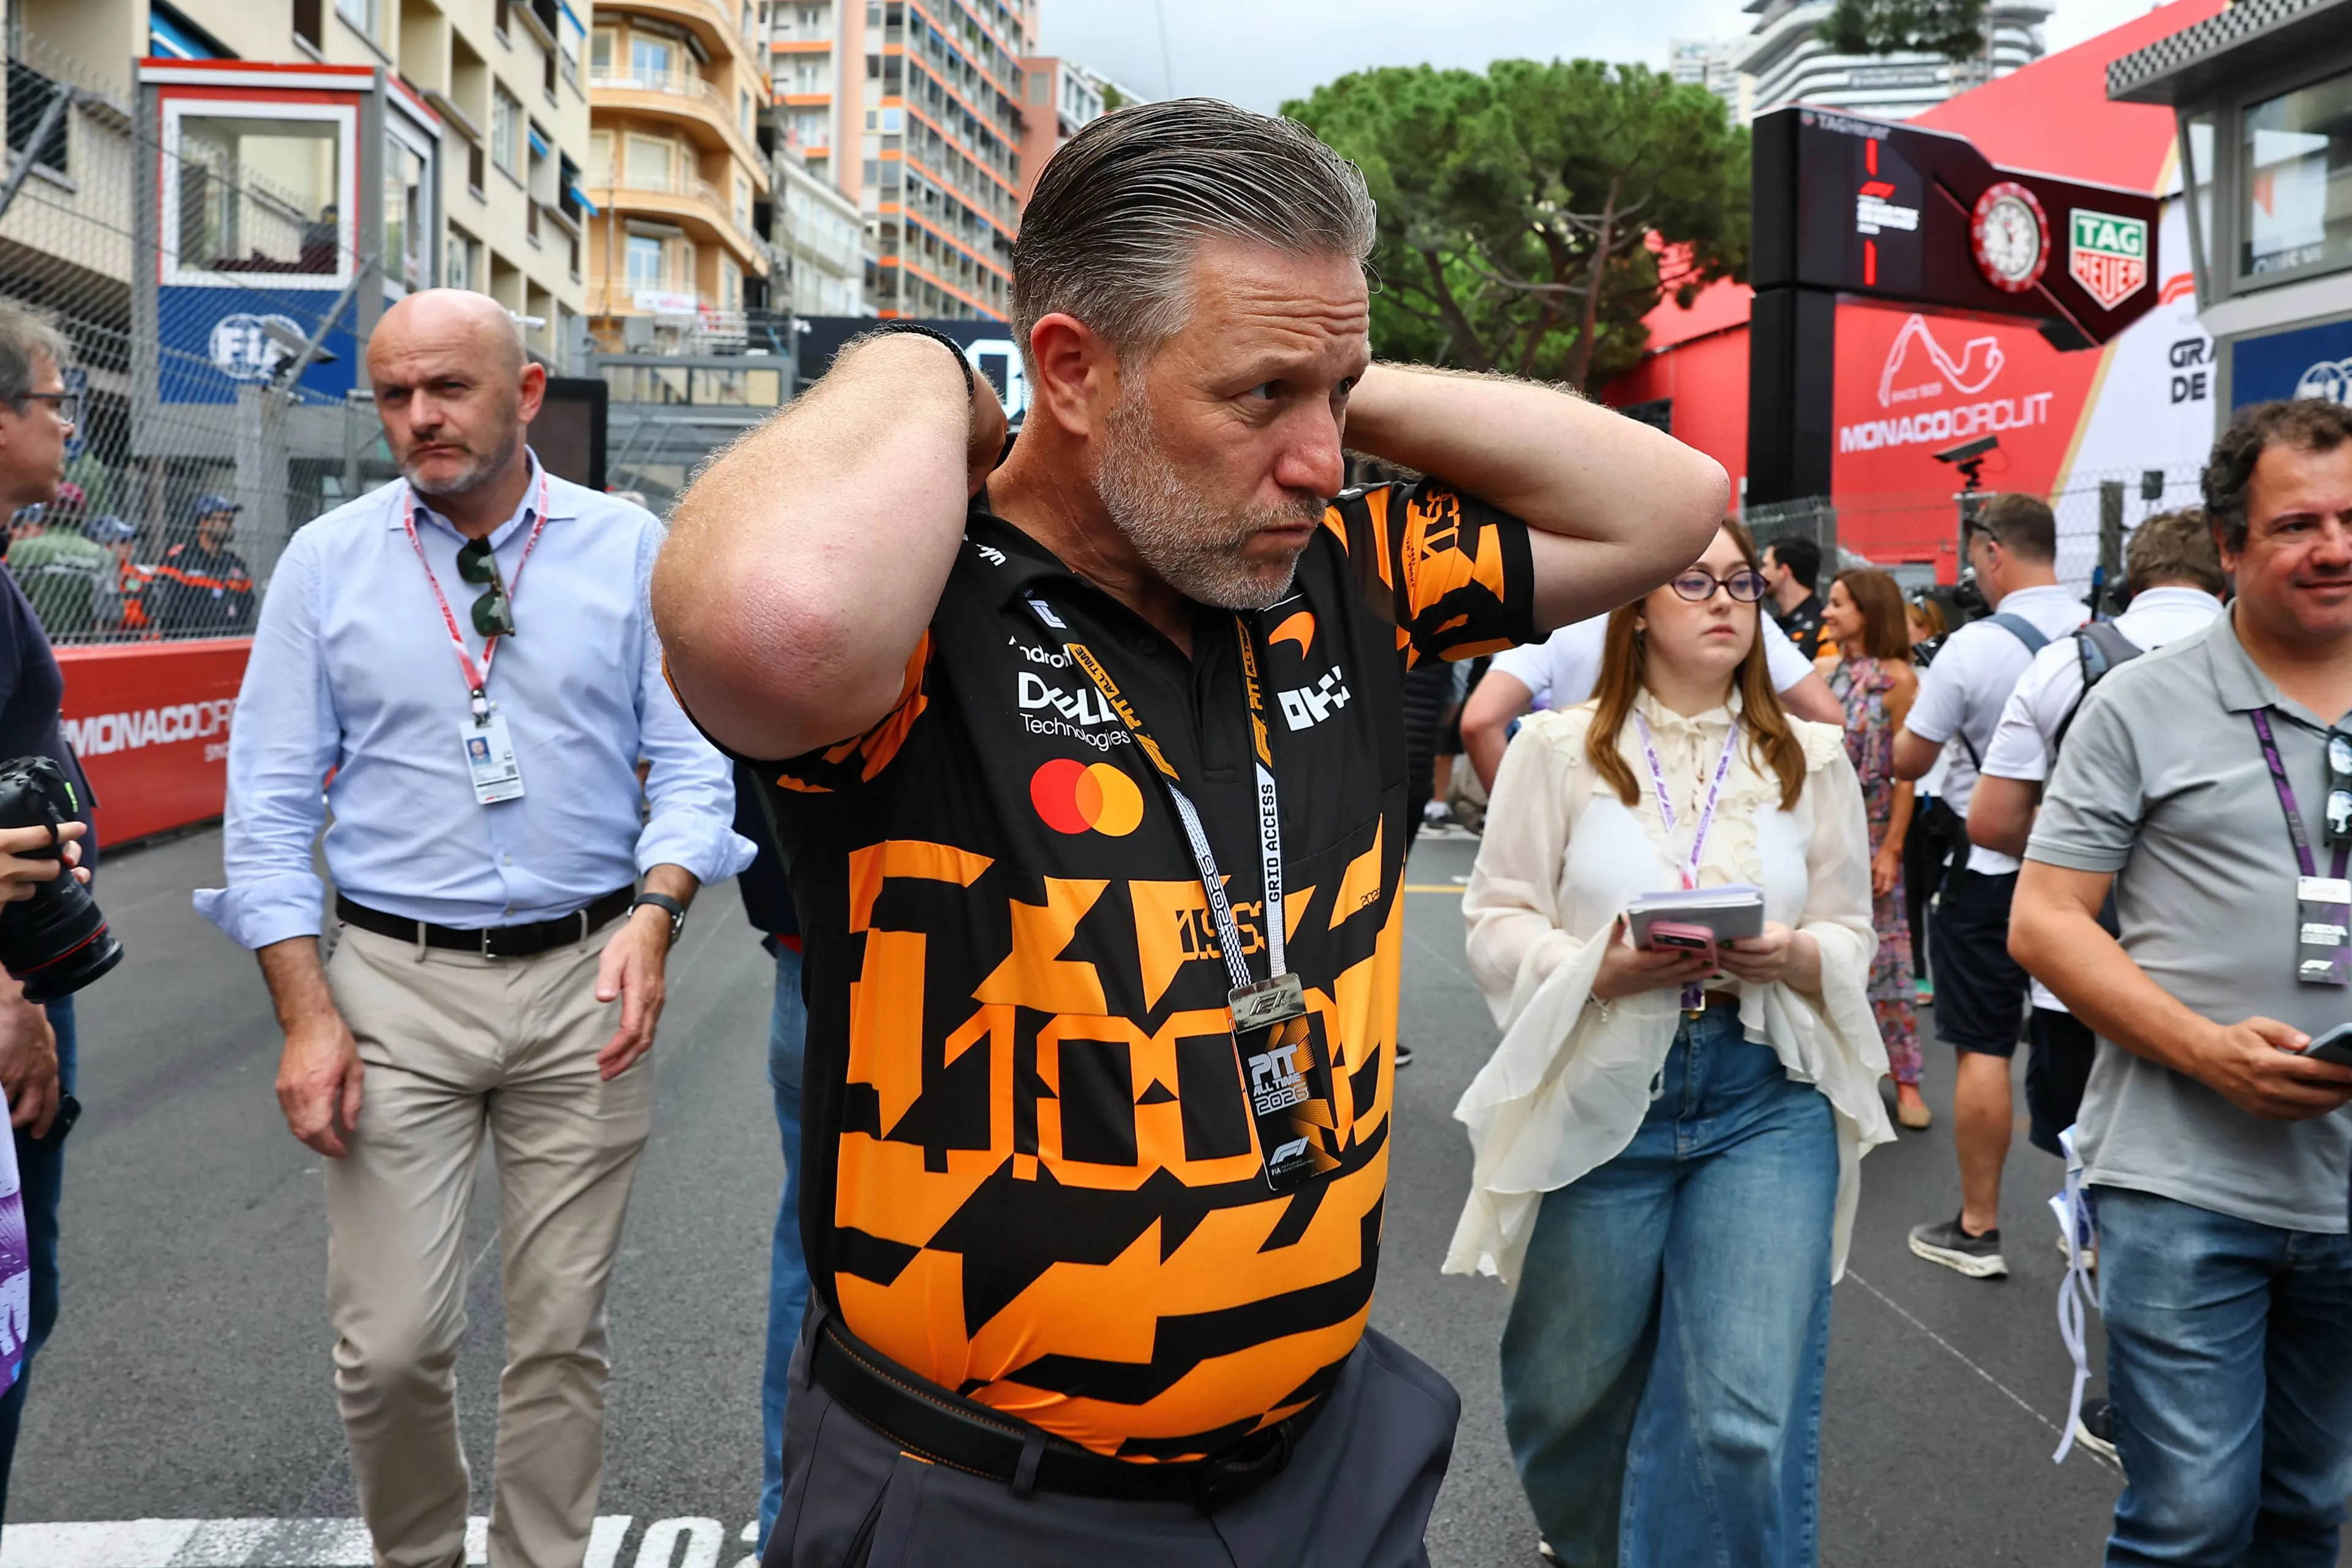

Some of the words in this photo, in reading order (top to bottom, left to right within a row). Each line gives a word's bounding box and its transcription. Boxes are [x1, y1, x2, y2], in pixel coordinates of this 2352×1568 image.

[2078, 218, 2140, 254] TAG
[2075, 254, 2146, 303] HEUER
[2171, 372, 2207, 404] DE
[1074, 646, 1101, 675] TIME
[1246, 655, 1254, 674] ALL
[1018, 671, 1119, 726] DELL
[1099, 674, 1116, 693] ALL
[1246, 677, 1264, 710] PIT
[1110, 699, 1142, 730] PIT
[1019, 712, 1131, 752] Technologies
[1261, 783, 1279, 851] ACCESS
[1265, 861, 1280, 903] GRID
[1248, 1044, 1299, 1085] PIT
[1253, 1082, 1274, 1097] ALL
[1275, 1071, 1302, 1091] TIME
[1254, 1084, 1311, 1117] 2026
[1269, 1135, 1310, 1166] F1
[1270, 1167, 1281, 1176] FIA
